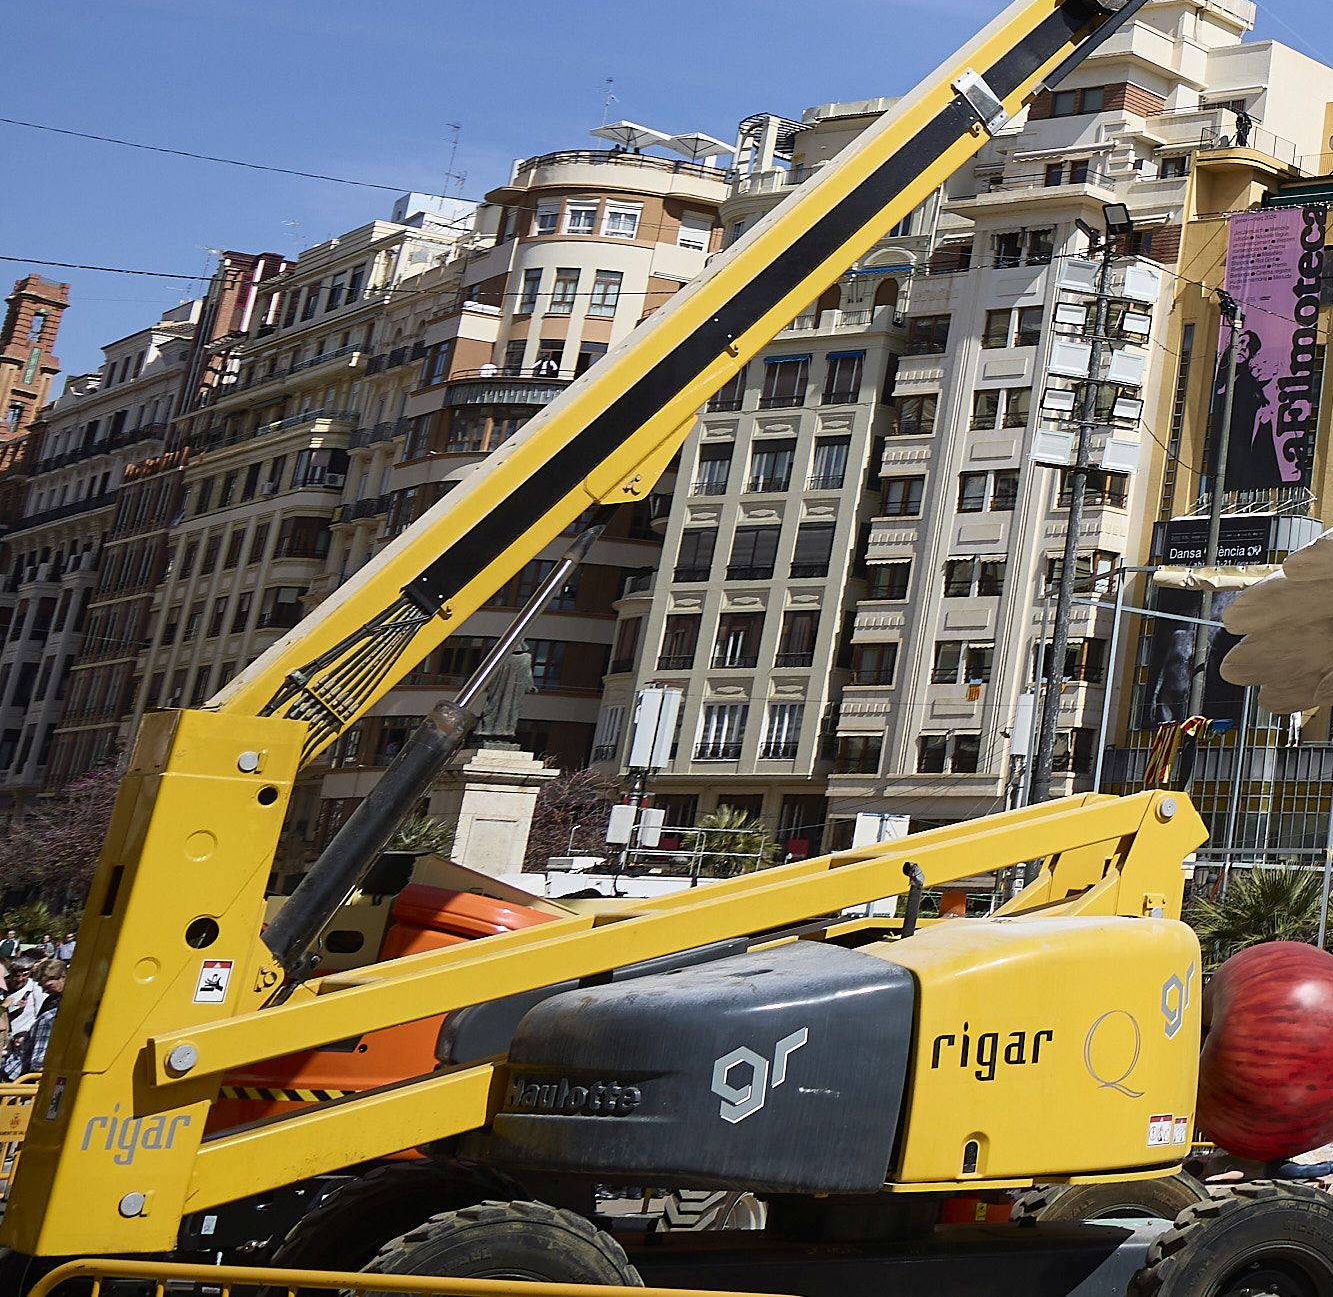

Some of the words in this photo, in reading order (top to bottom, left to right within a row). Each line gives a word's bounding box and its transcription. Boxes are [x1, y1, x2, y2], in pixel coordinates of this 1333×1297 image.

[1169, 548, 1202, 560] Dansa
[931, 1021, 1053, 1082] rigar
[1084, 1010, 1145, 1098] Q
[508, 1079, 641, 1110] Haulotte
[81, 1103, 191, 1166] rigar
